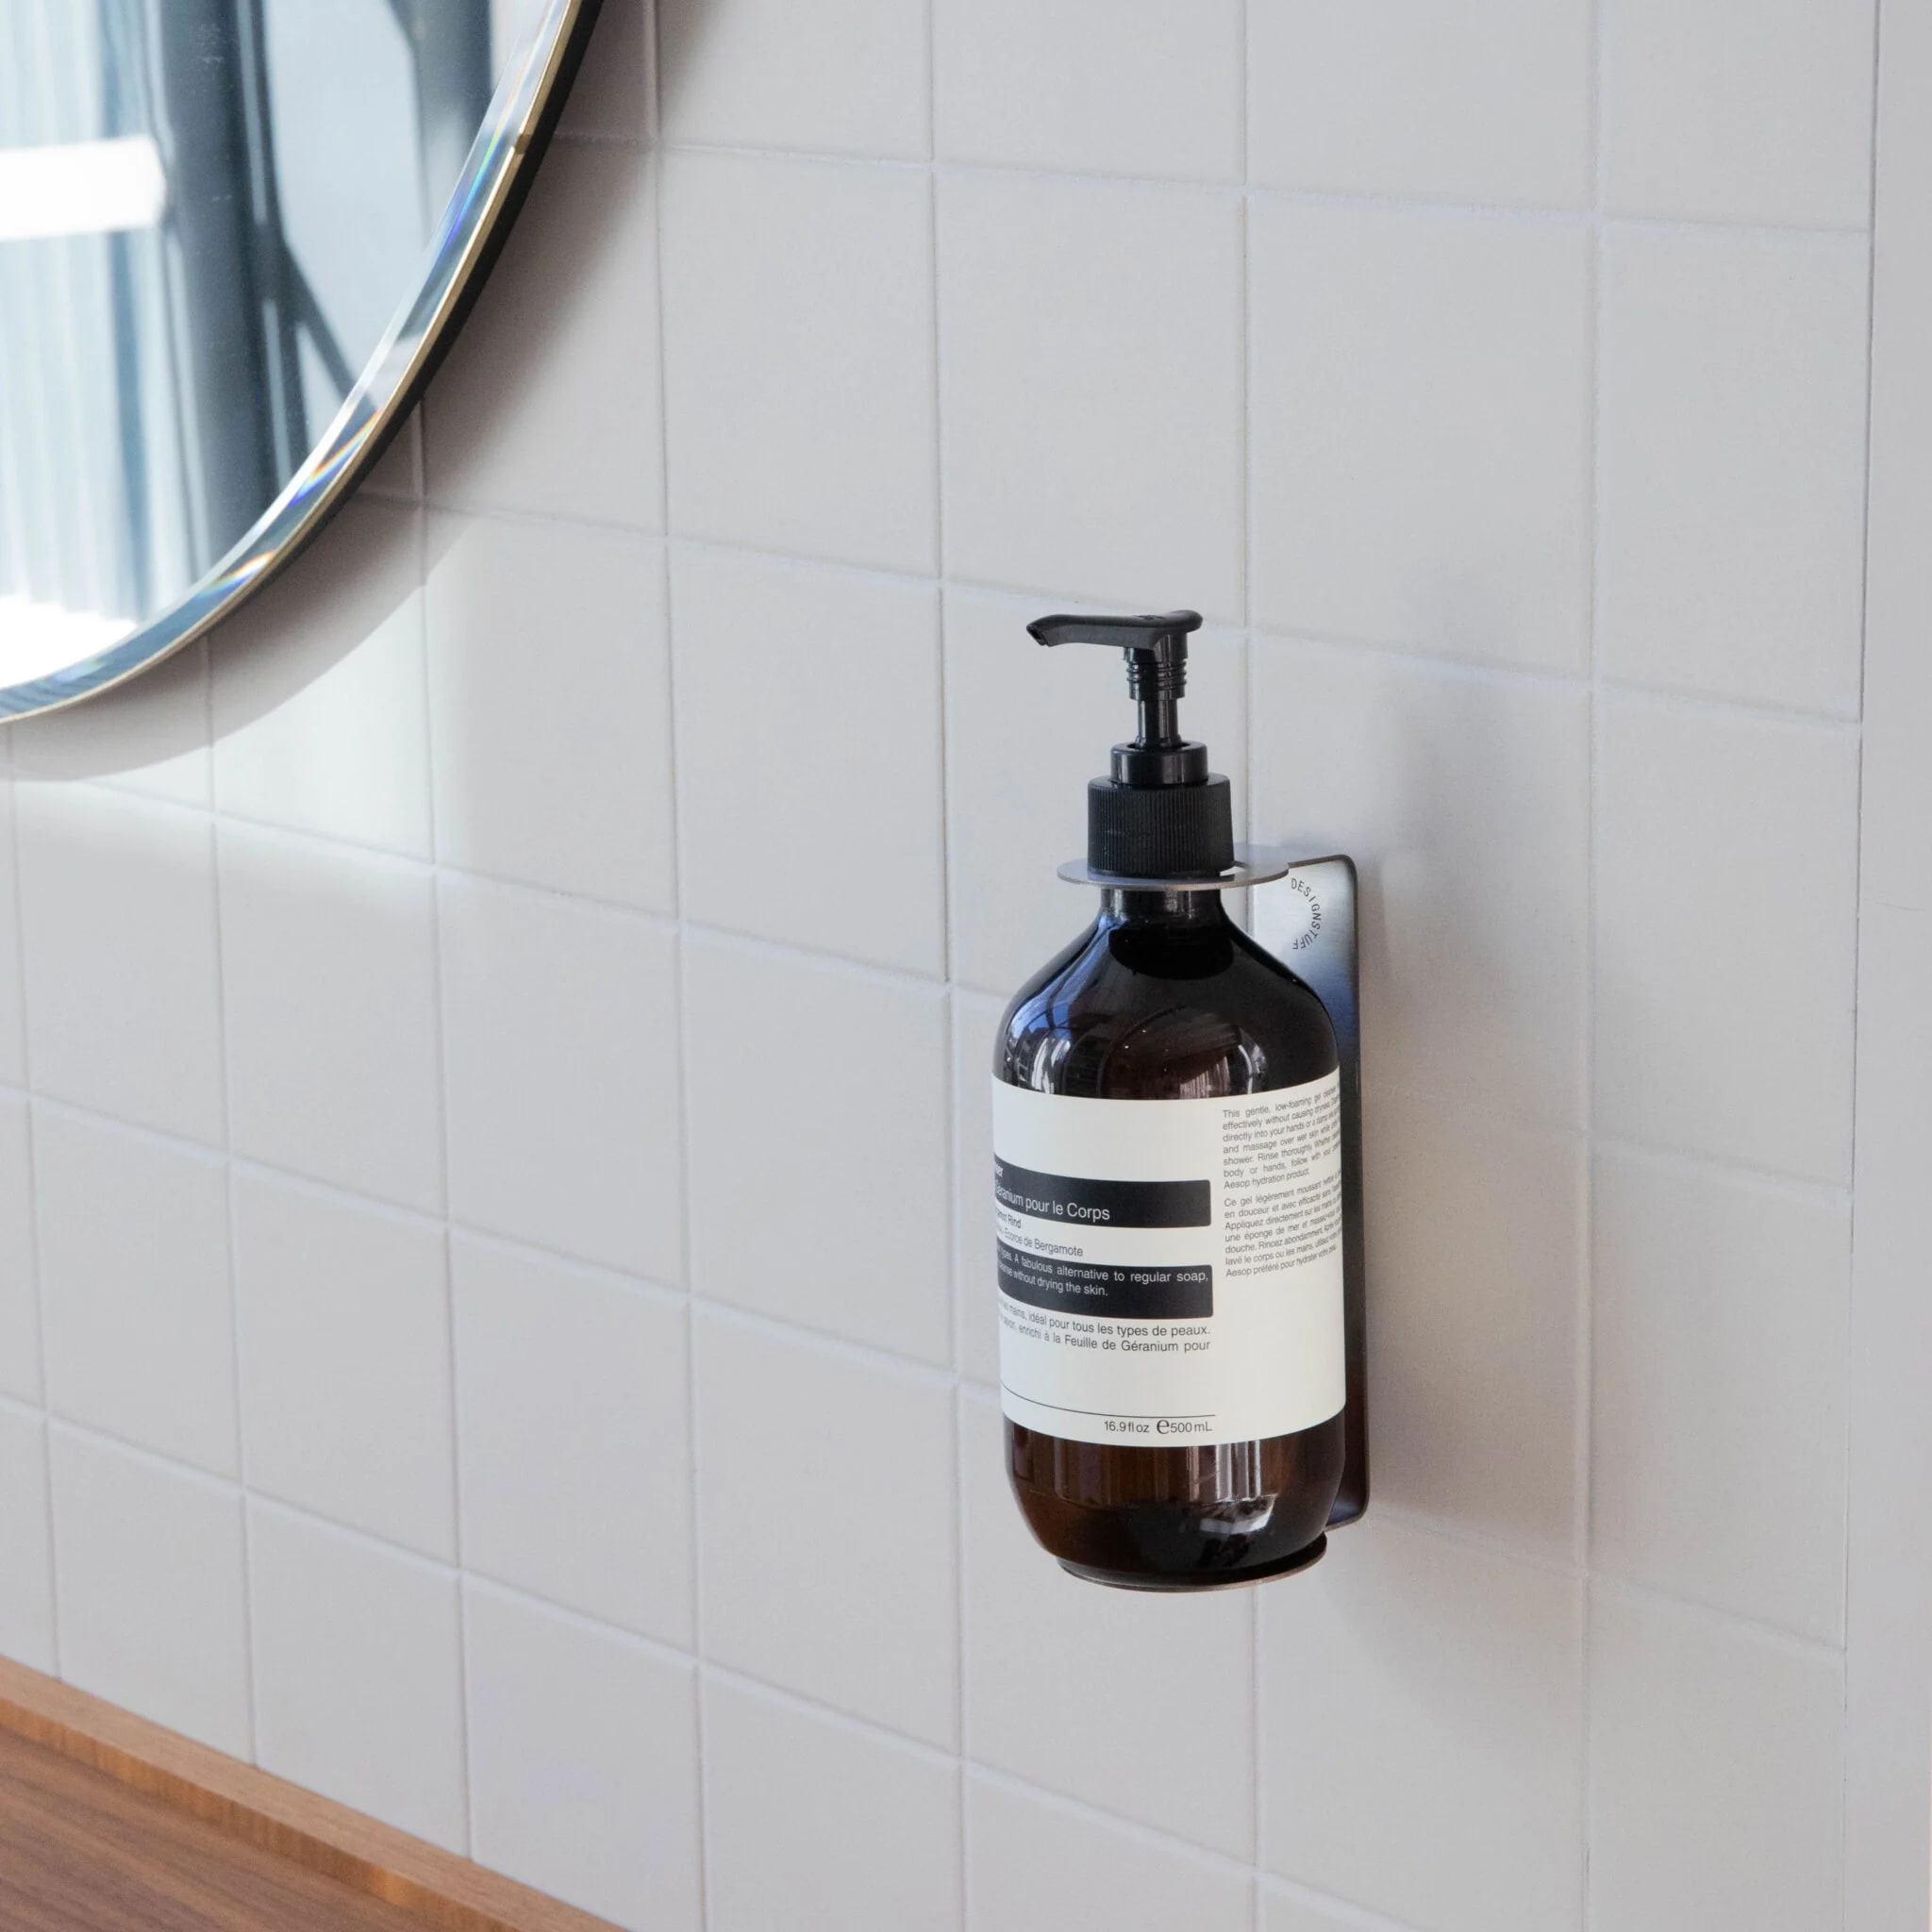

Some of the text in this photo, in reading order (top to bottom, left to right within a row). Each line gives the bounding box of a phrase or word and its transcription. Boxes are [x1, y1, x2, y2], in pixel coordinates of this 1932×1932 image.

[1291, 877, 1321, 950] DESIGNSTUFF
[1223, 1109, 1241, 1118] This
[1223, 1119, 1262, 1130] effectively
[1266, 1113, 1290, 1124] without
[1291, 1108, 1313, 1120] causing
[1223, 1130, 1252, 1142] directly
[1255, 1129, 1268, 1138] into
[1270, 1128, 1284, 1138] your
[1287, 1123, 1305, 1132] hands
[1223, 1145, 1239, 1154] and
[1243, 1141, 1277, 1151] massage
[1280, 1138, 1294, 1146] over
[1224, 1157, 1255, 1166] shower.
[1257, 1152, 1279, 1161] Rinse
[1224, 1168, 1245, 1178] body
[1224, 1179, 1250, 1190] Aesop
[1252, 1174, 1286, 1186] hydration
[1224, 1198, 1237, 1207] Ce
[1240, 1195, 1253, 1207] gel
[1257, 1189, 1295, 1204] légèrement
[1025, 1198, 1050, 1213] pour
[1053, 1200, 1064, 1215] le
[1067, 1202, 1110, 1223] Corps
[1239, 1206, 1270, 1217] douceur
[1272, 1204, 1279, 1212] et
[1282, 1201, 1297, 1210] avec
[1225, 1219, 1263, 1231] Appliquez
[1266, 1210, 1303, 1225] directement
[1225, 1233, 1241, 1241] une
[1244, 1228, 1273, 1241] éponge
[1275, 1226, 1285, 1235] de
[1288, 1223, 1300, 1232] mer
[1024, 1237, 1033, 1247] de
[1035, 1238, 1084, 1257] Bergamote
[1225, 1243, 1256, 1254] douche.
[1258, 1239, 1283, 1250] Rincez
[1225, 1256, 1242, 1265] lavé
[1244, 1255, 1252, 1263] le
[1253, 1253, 1274, 1263] corps
[1275, 1250, 1285, 1258] ou
[1286, 1247, 1295, 1256] les
[1014, 1253, 1020, 1264] A
[1021, 1256, 1054, 1274] fabulous
[1057, 1265, 1108, 1281] alternative
[1113, 1271, 1125, 1282] to
[1130, 1271, 1172, 1285] regular
[1176, 1272, 1208, 1284] soap,
[1225, 1267, 1252, 1277] Aesop
[1253, 1263, 1279, 1275] préféré
[1280, 1259, 1295, 1270] pour
[1014, 1268, 1036, 1285] without
[1038, 1277, 1064, 1293] drying
[1066, 1282, 1081, 1293] the
[1083, 1284, 1108, 1296] skin.
[1029, 1311, 1047, 1326] idéal
[1049, 1317, 1070, 1329] pour
[1073, 1321, 1094, 1333] tous
[1097, 1323, 1113, 1335] les
[1116, 1324, 1149, 1338] types
[1152, 1324, 1167, 1336] de
[1171, 1325, 1211, 1339] peaux.
[1019, 1324, 1041, 1340] enrichi
[1044, 1330, 1050, 1341] à
[1053, 1331, 1061, 1343] la
[1065, 1334, 1098, 1349] Feuille
[1102, 1338, 1116, 1350] de
[1121, 1340, 1179, 1352] Géranium
[1184, 1341, 1211, 1354] pour
[1104, 1421, 1126, 1432] 16.9
